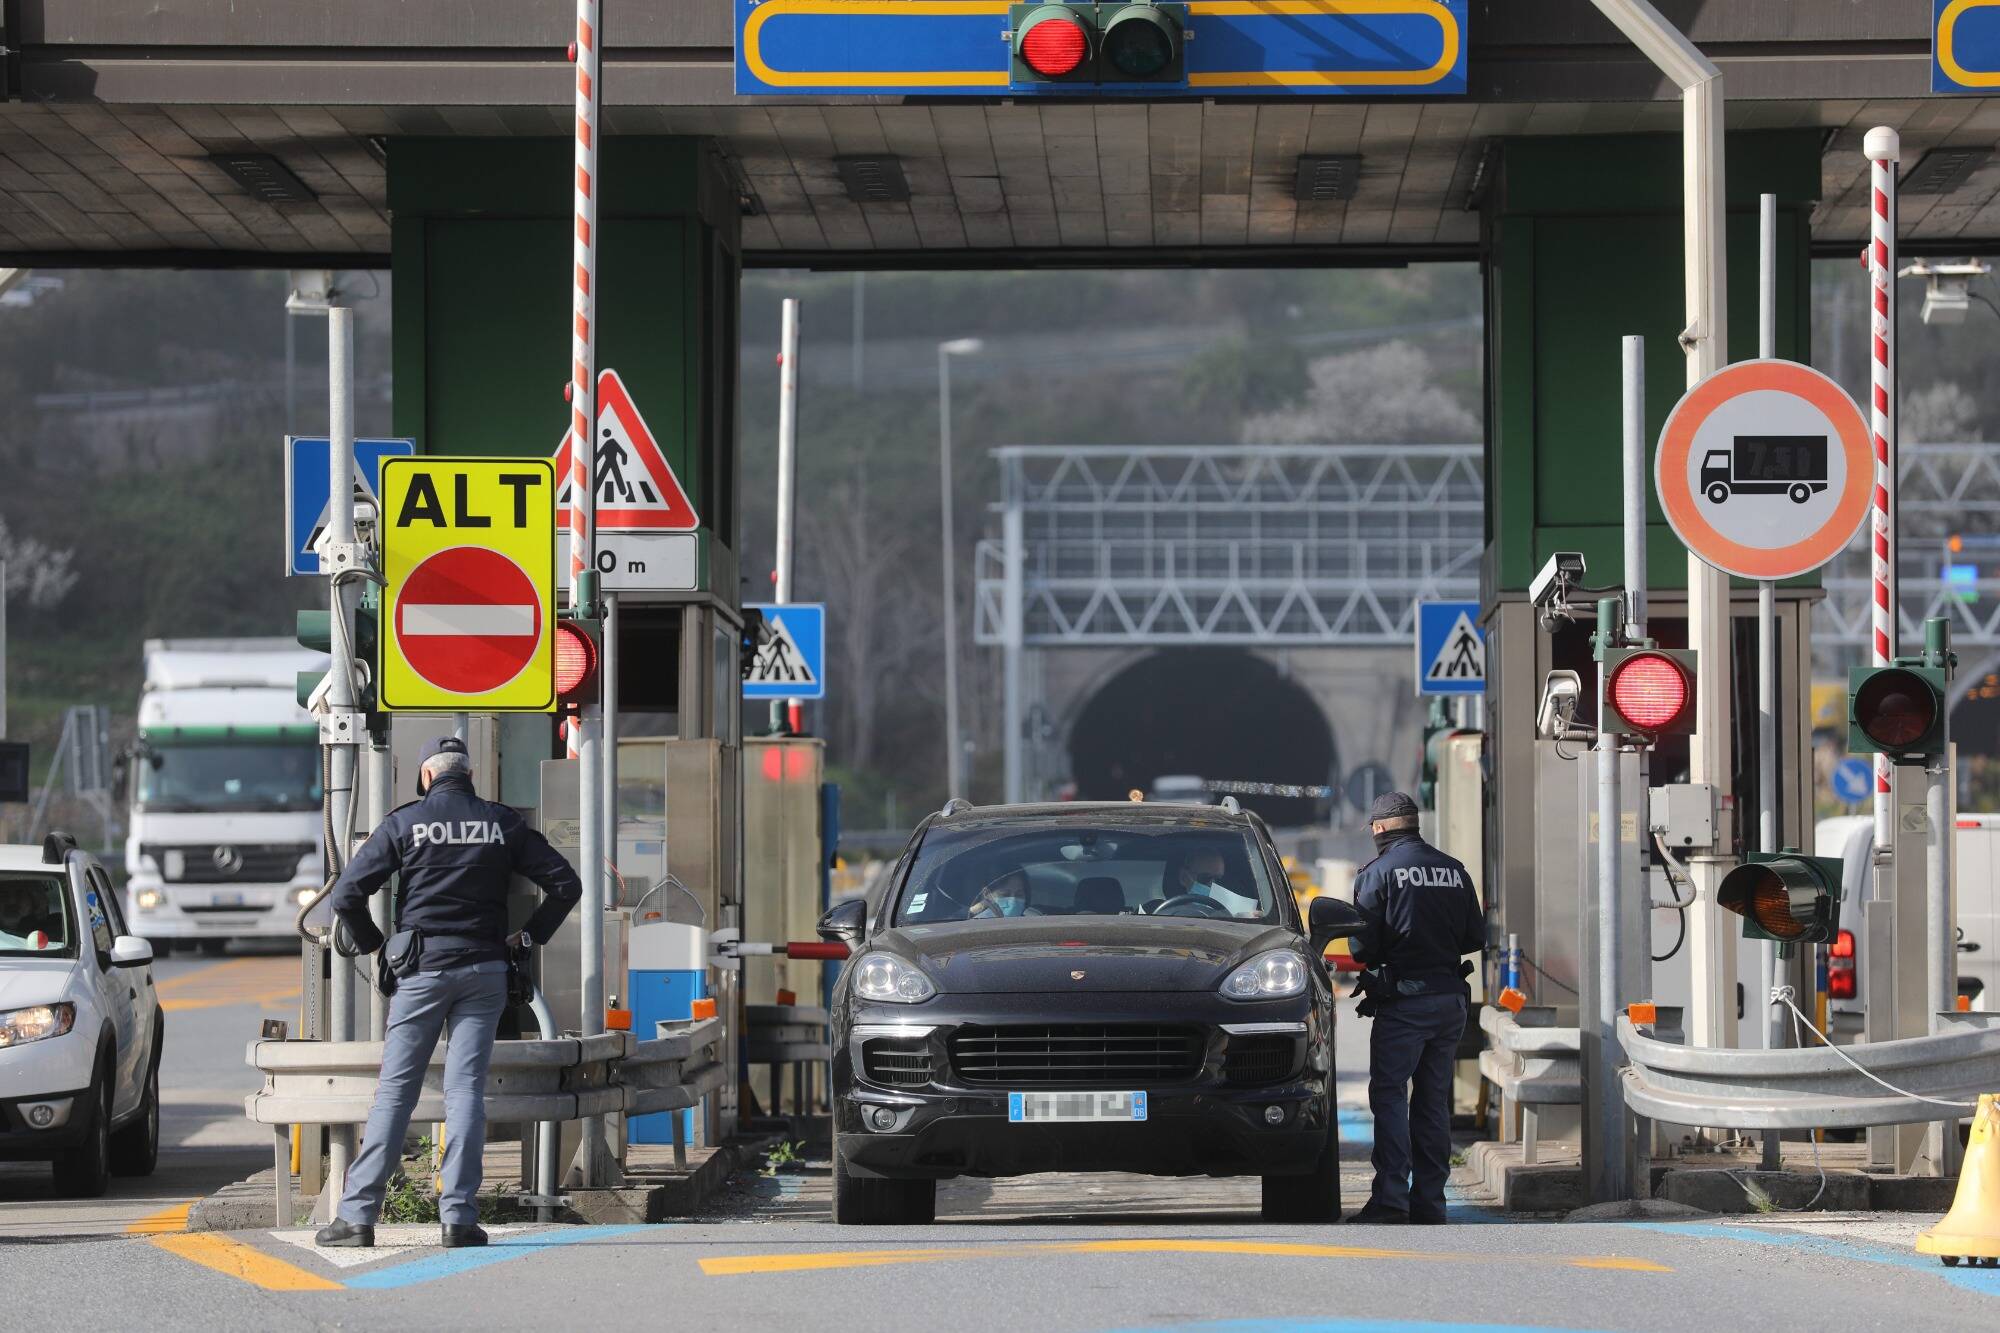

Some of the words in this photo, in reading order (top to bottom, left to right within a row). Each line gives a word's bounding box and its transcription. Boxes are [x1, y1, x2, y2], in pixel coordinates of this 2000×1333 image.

[397, 474, 542, 528] ALT
[628, 561, 646, 574] m
[411, 820, 507, 848] POLIZIA
[1394, 866, 1463, 889] POLIZIA
